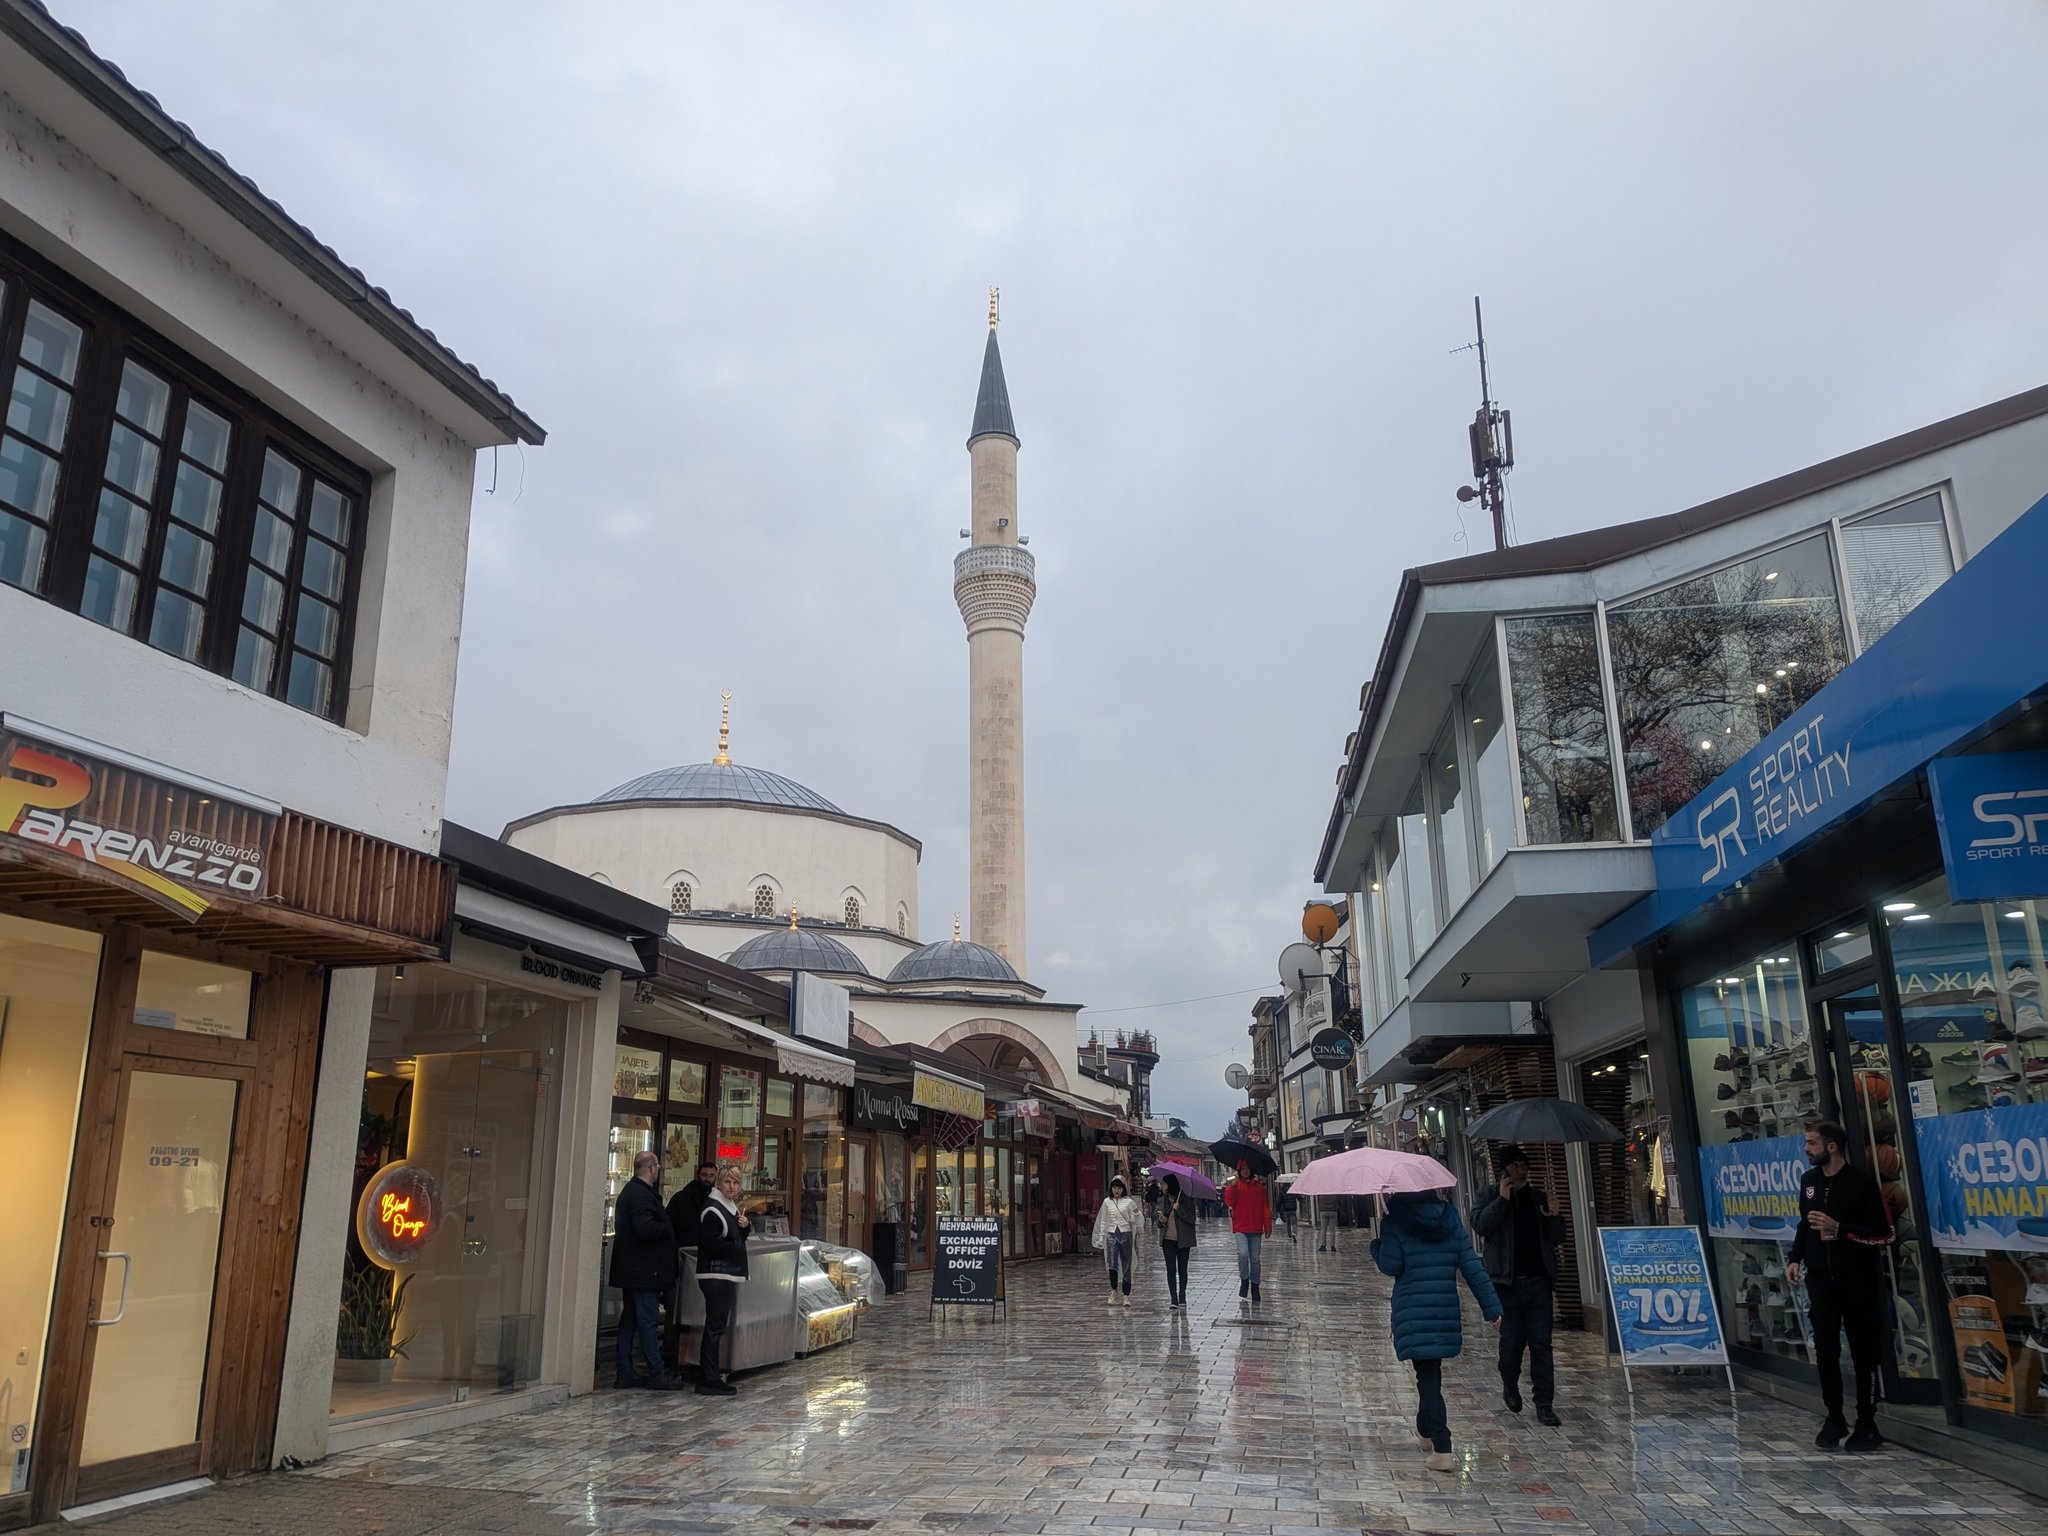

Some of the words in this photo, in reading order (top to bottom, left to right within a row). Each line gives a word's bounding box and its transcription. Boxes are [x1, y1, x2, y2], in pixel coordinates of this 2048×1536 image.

[1749, 713, 1825, 807] SPORT
[1754, 741, 1852, 846] REALITY
[169, 829, 261, 864] avantgarde
[1697, 786, 1747, 884] SR
[1966, 847, 2023, 861] SPORT
[521, 957, 559, 979] BLOOD
[561, 967, 602, 991] ORANGE
[858, 1088, 892, 1120] Monna
[892, 1096, 919, 1129] Rossa
[149, 1156, 199, 1167] 09-21
[1720, 1159, 1805, 1193] СЕЗОНСКО
[940, 1222, 998, 1233] МЕНУВАЧНИЦА
[940, 1236, 998, 1245] EXCHANGE
[946, 1246, 986, 1255] OFFICE
[1611, 1263, 1700, 1275] СЕЗОНСКО
[1613, 1275, 1703, 1284] НАМАЛУВАЊЕ
[1628, 1288, 1708, 1323] 70%
